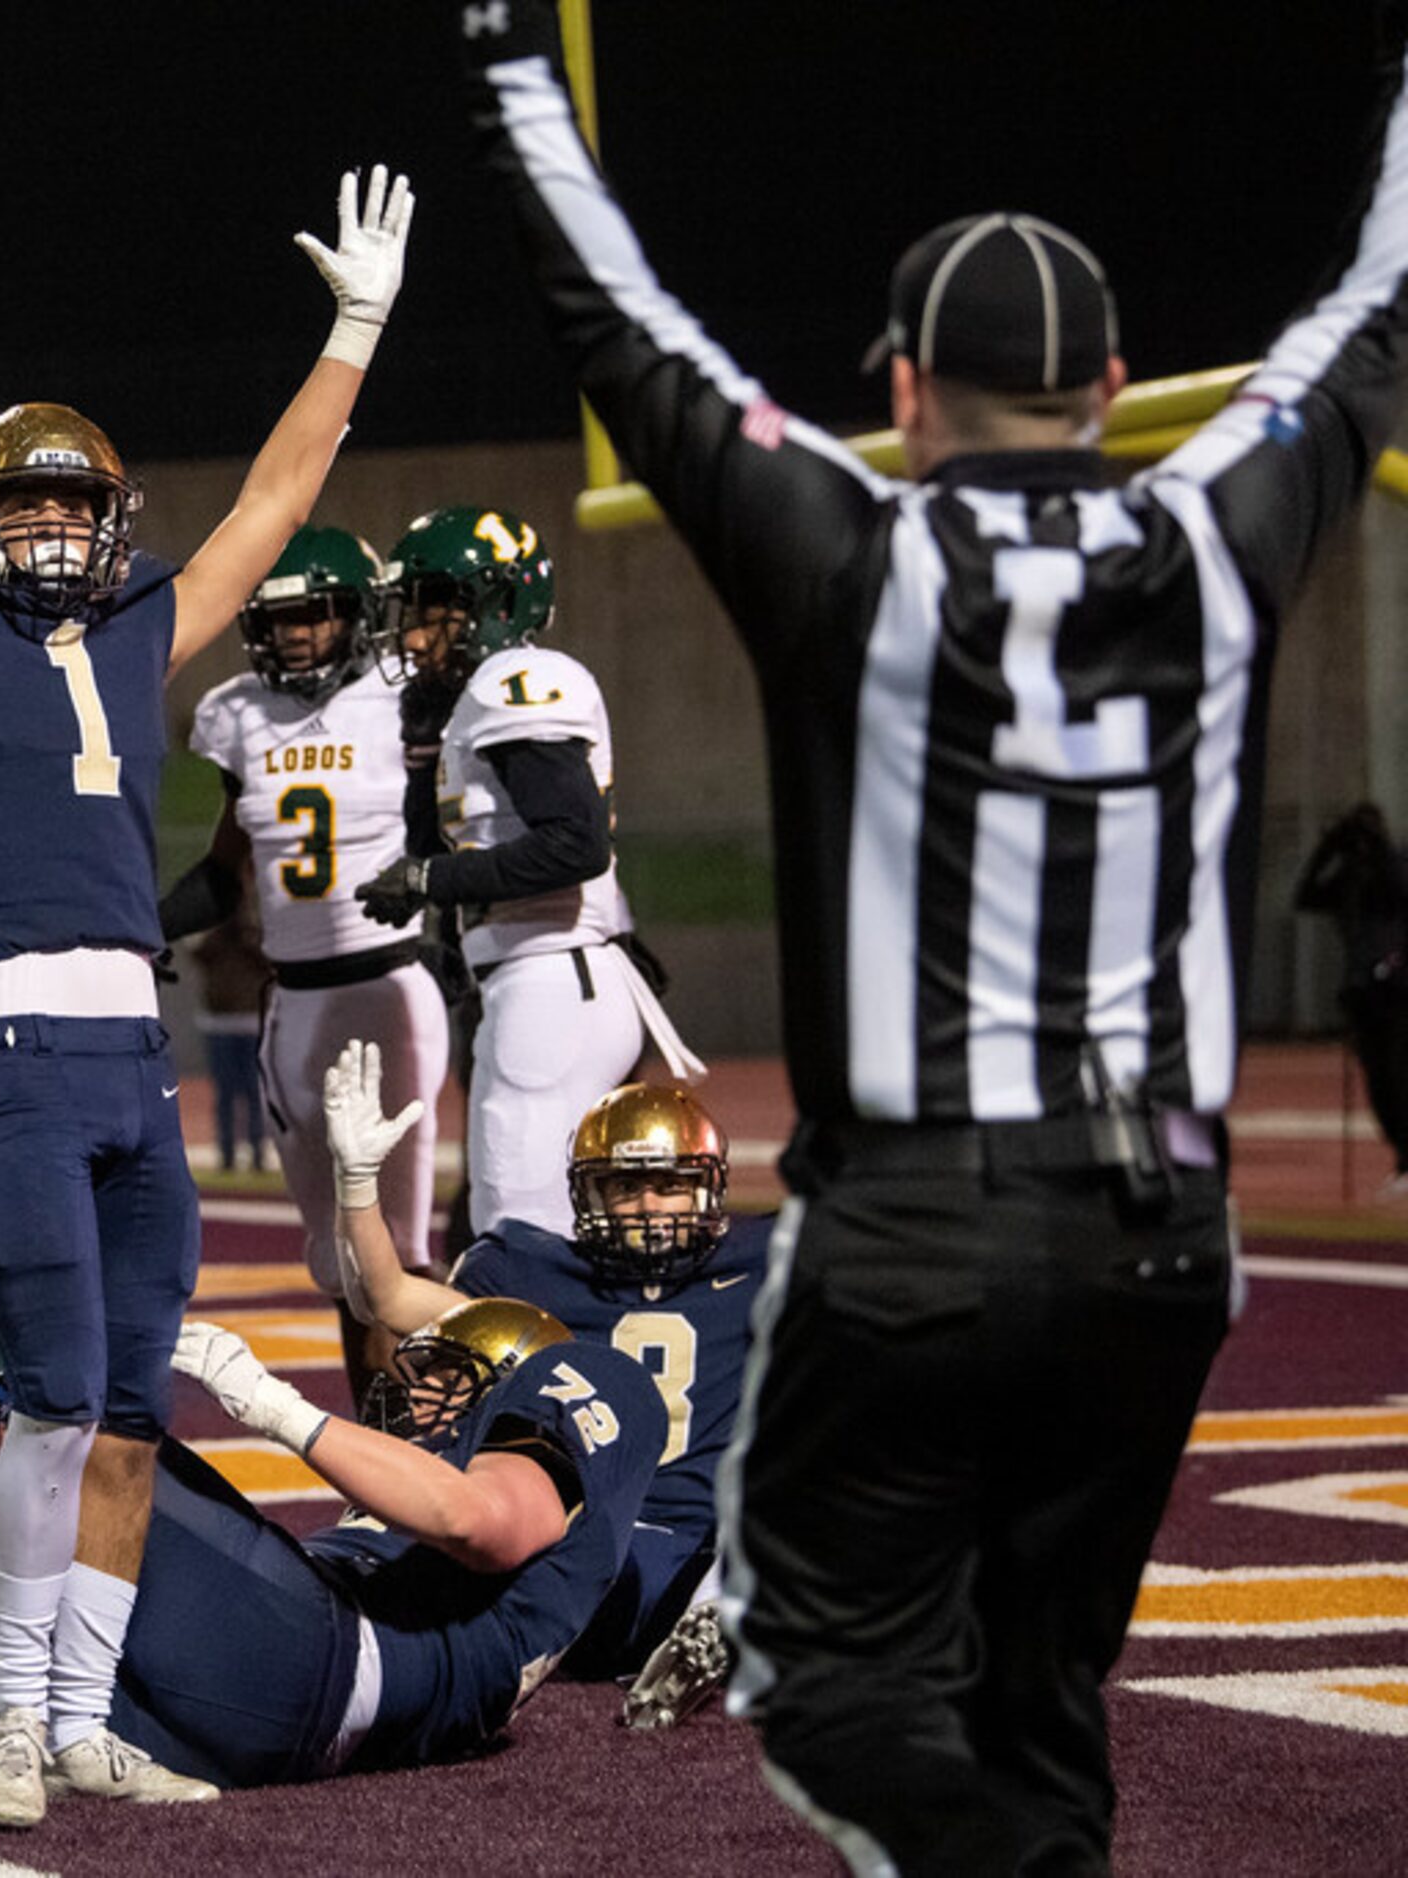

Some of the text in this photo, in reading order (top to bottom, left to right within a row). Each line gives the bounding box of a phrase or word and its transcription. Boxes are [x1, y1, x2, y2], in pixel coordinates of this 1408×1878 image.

[44, 620, 122, 796] 1
[500, 669, 563, 708] L
[993, 548, 1149, 780] L
[264, 743, 354, 775] LOBOS
[276, 783, 337, 900] 3
[537, 1361, 620, 1456] 72
